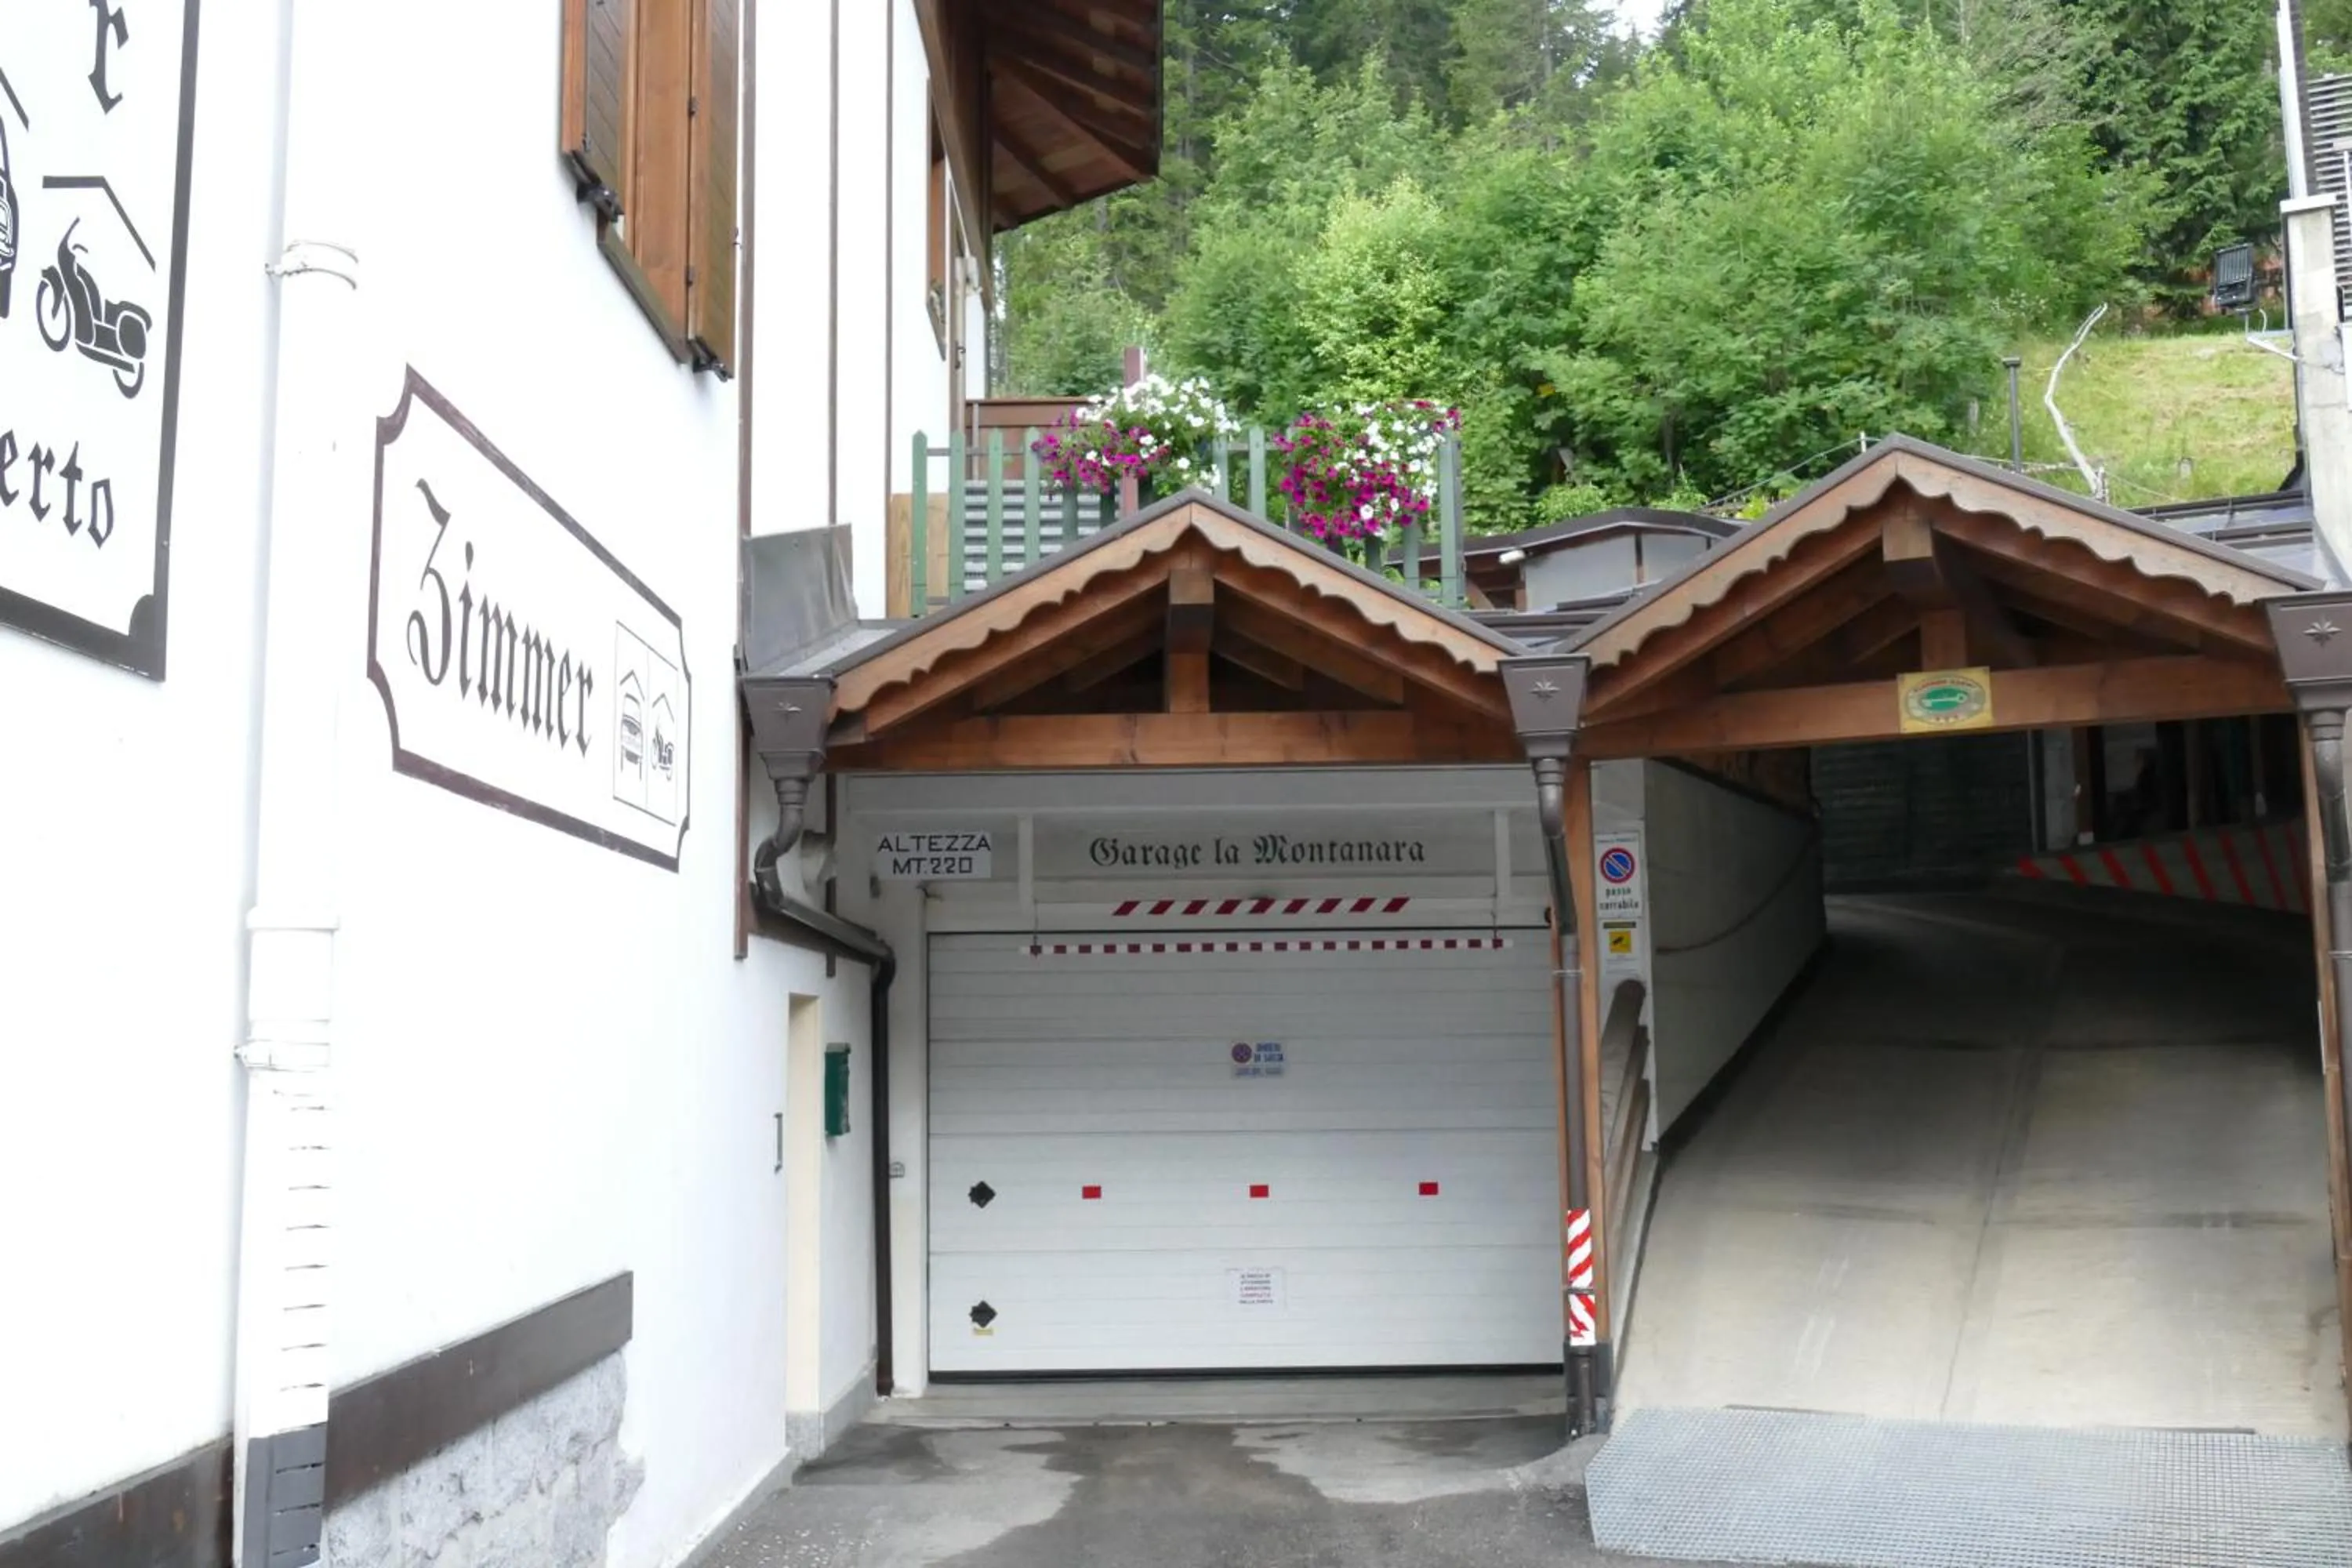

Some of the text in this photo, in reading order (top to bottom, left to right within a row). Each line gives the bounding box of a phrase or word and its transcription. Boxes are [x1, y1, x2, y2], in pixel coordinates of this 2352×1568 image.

[407, 478, 594, 760] Zimmer
[877, 835, 991, 852] ALTEZZA
[1090, 834, 1426, 869] Garage la Montanara
